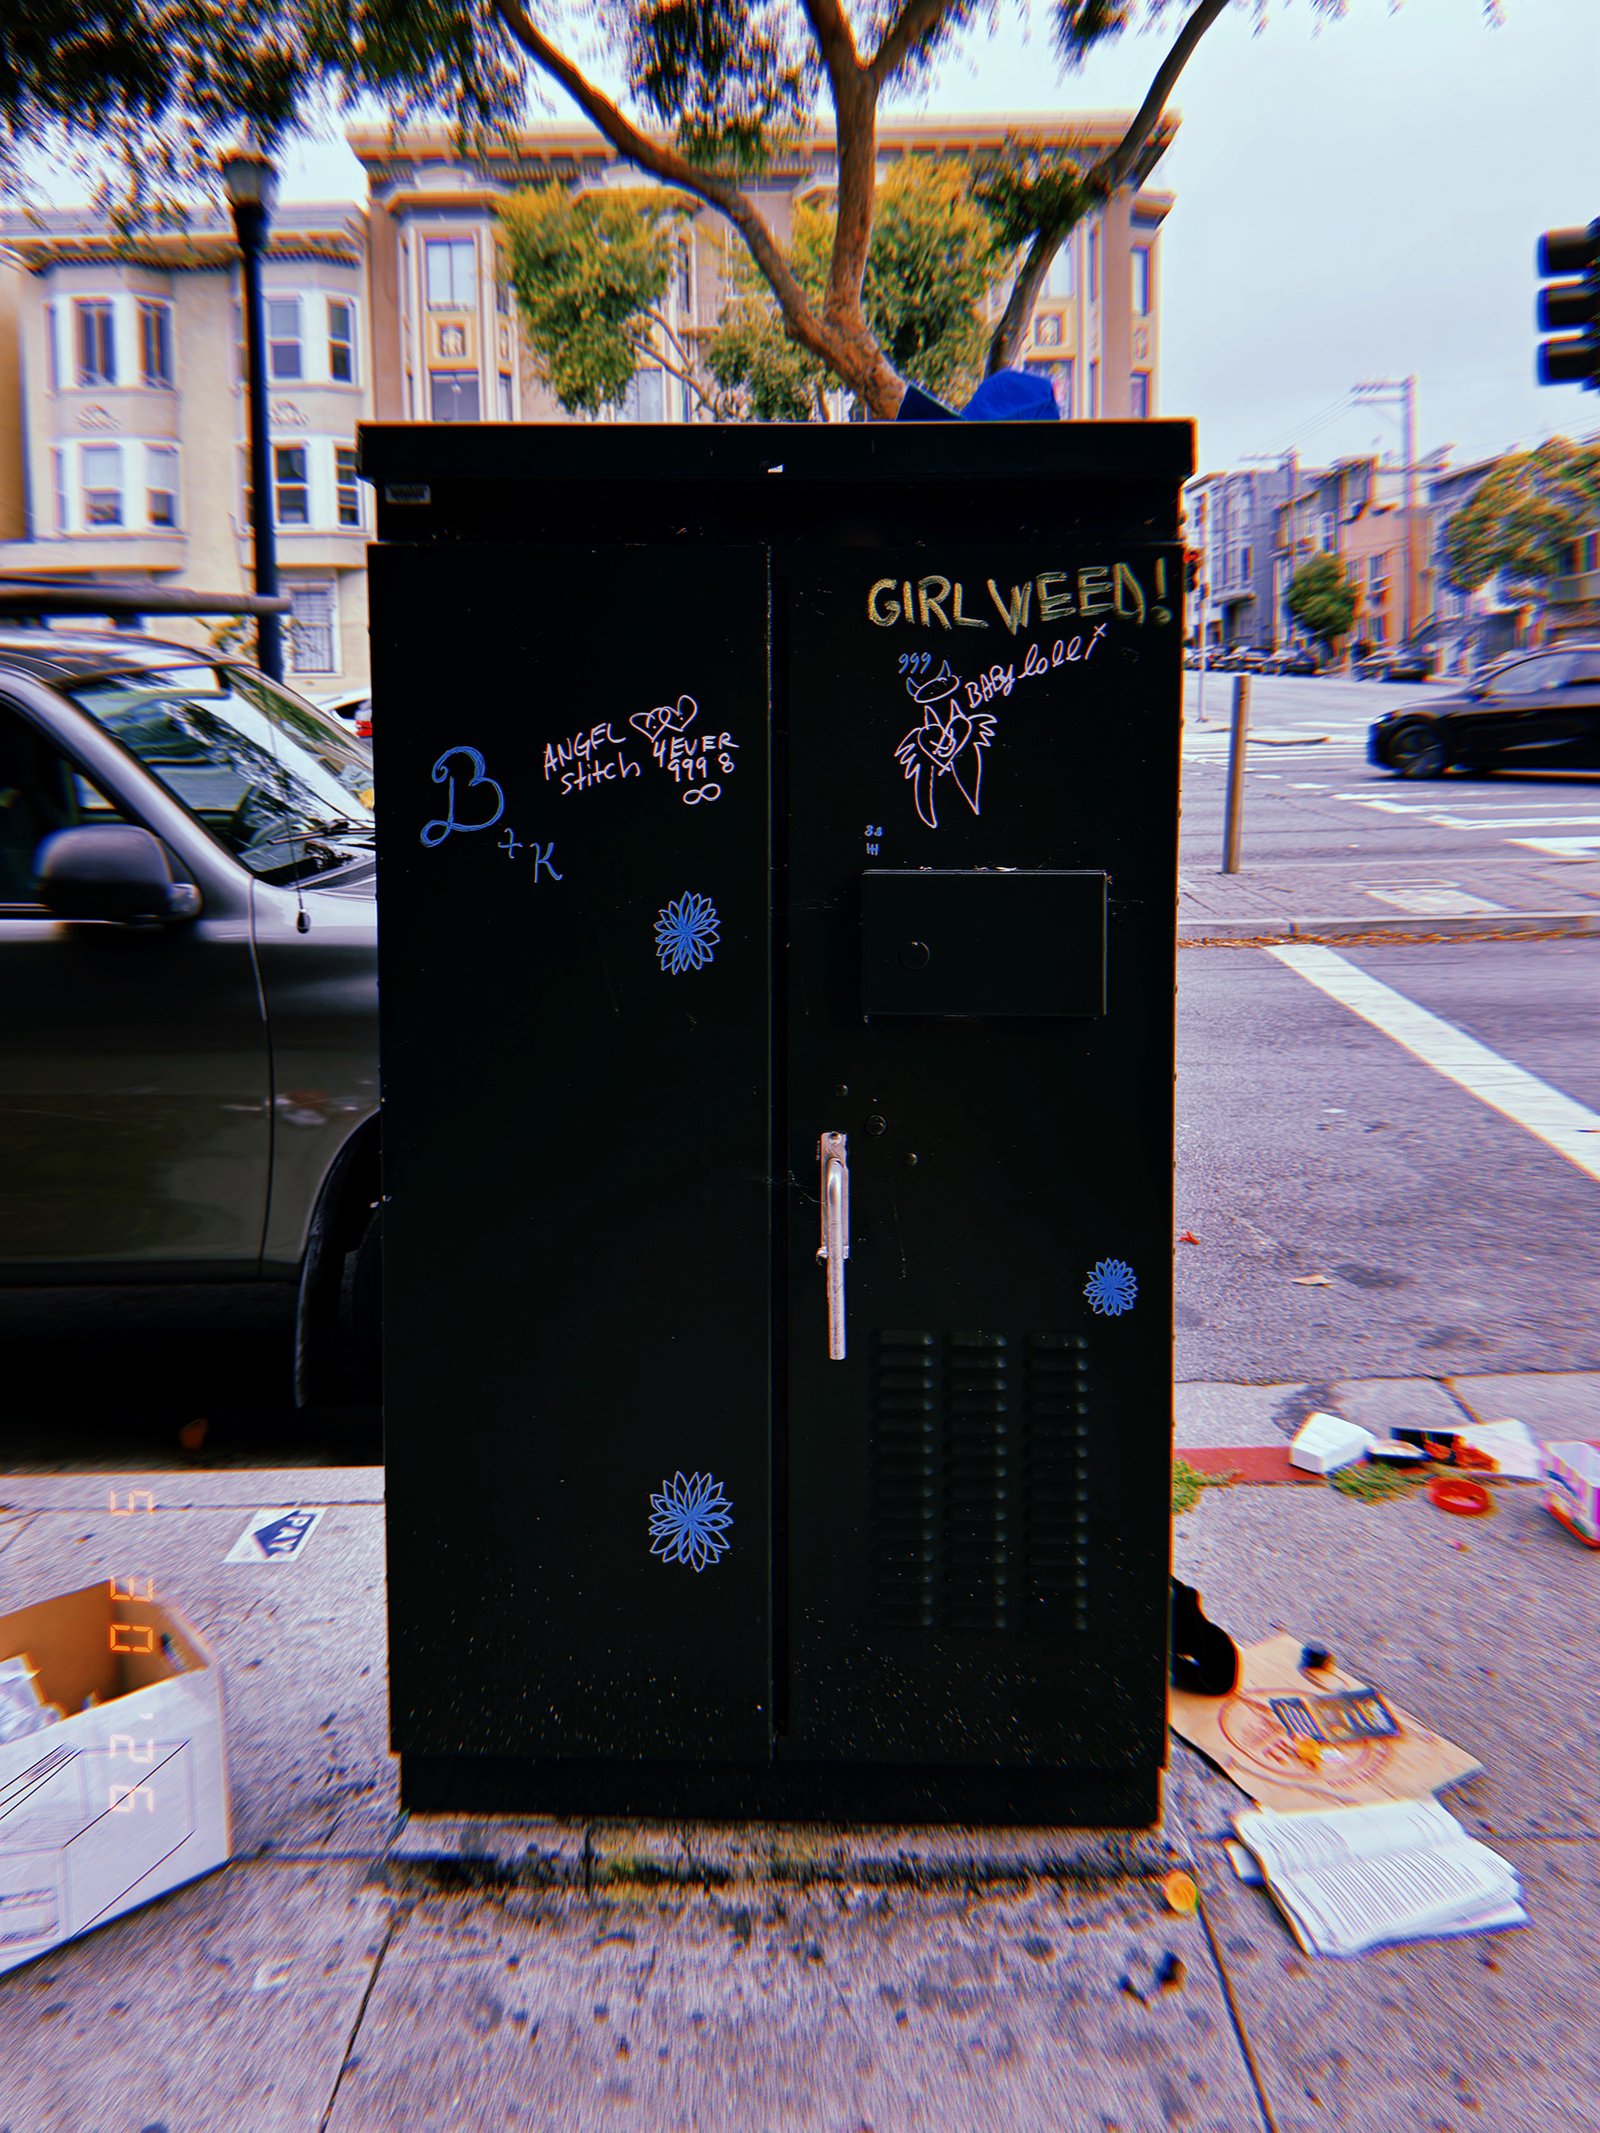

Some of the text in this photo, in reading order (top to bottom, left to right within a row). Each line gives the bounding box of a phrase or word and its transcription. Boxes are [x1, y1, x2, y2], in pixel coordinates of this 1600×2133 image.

[868, 557, 1172, 636] GIRL WEED!
[542, 722, 627, 781] ANGEL
[419, 745, 505, 848] B
[529, 841, 564, 884] K
